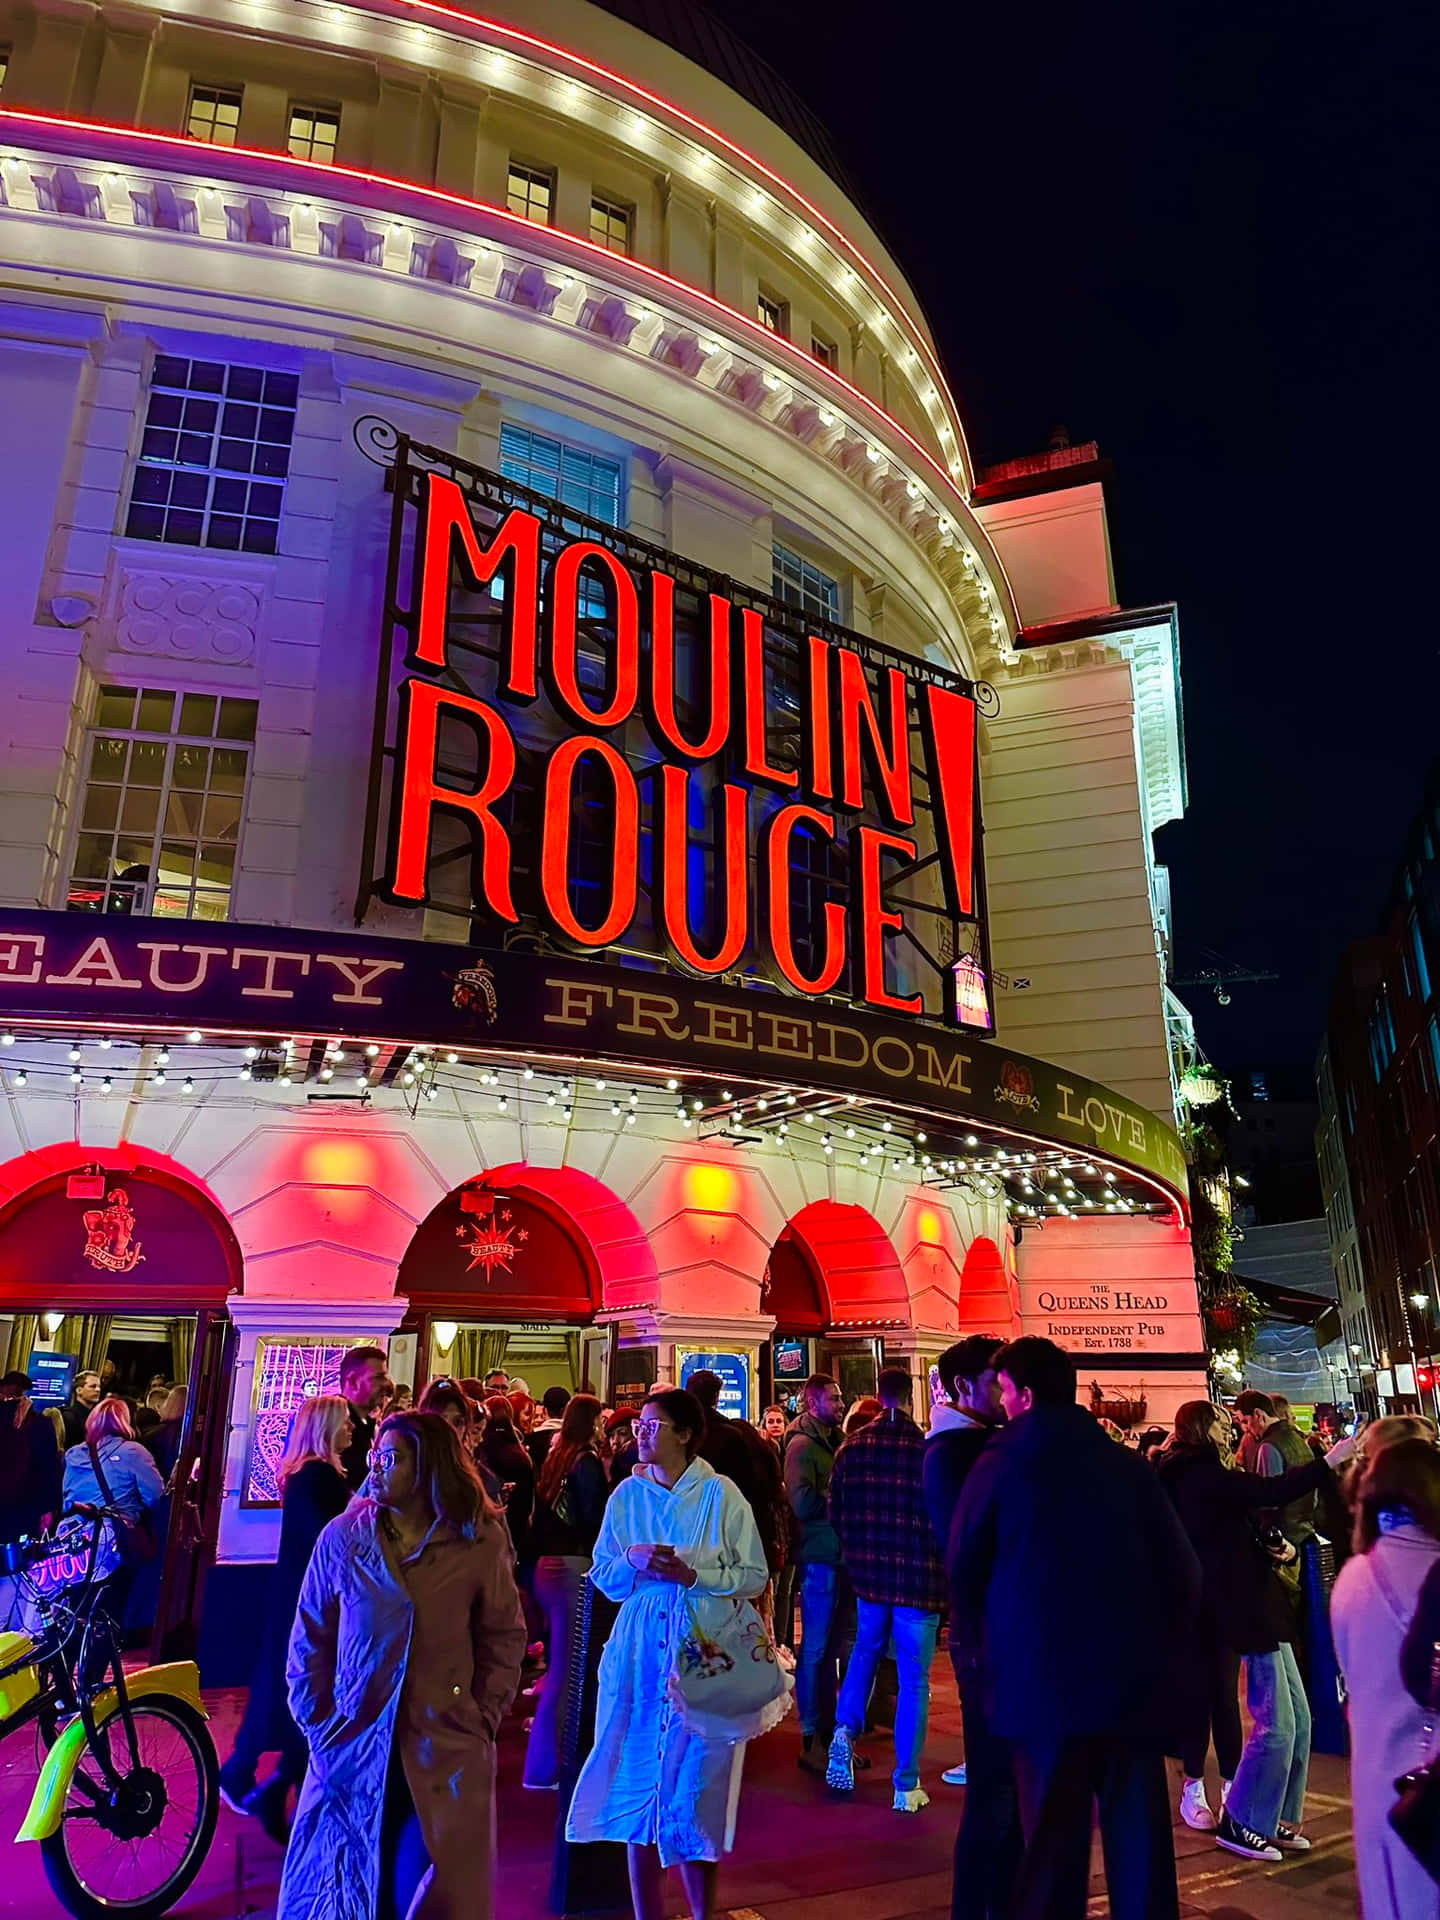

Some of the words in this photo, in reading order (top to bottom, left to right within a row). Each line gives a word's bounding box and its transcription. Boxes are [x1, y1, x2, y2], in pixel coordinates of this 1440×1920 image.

[416, 472, 914, 826] MOULIN
[543, 978, 972, 1094] FREEDOM
[1056, 1083, 1147, 1153] LOVE
[1038, 1292, 1109, 1311] QUEENS
[1114, 1292, 1168, 1310] HEAD
[1090, 1285, 1110, 1293] THE
[1047, 1322, 1134, 1336] INDEPENDENT
[1138, 1322, 1165, 1335] PUB
